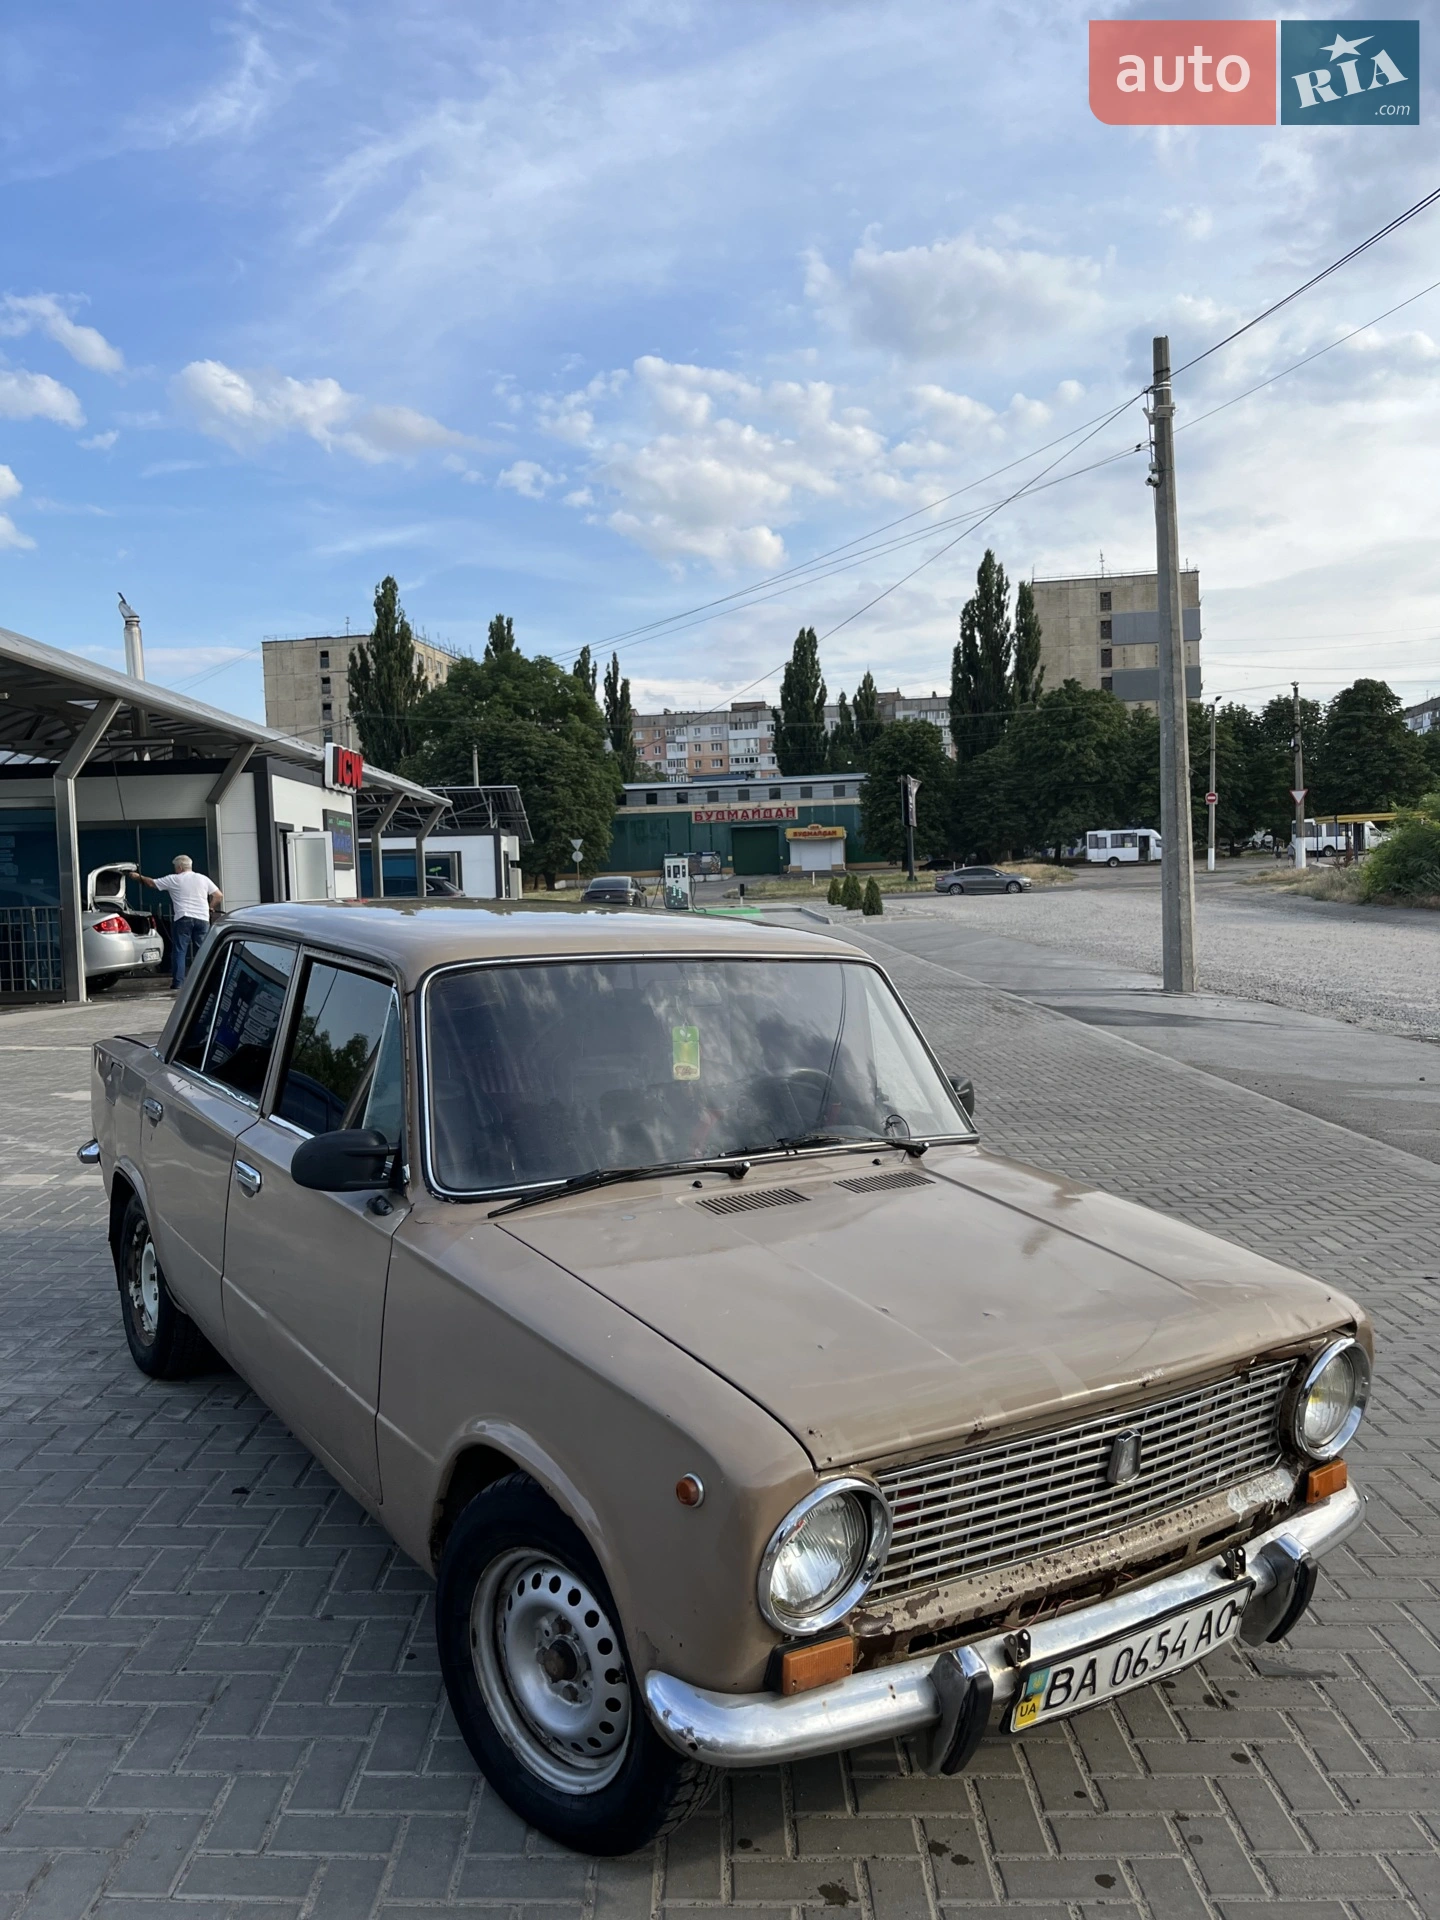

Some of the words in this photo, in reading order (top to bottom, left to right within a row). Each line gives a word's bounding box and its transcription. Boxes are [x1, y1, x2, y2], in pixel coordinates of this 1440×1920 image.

[335, 745, 364, 789] ICW
[694, 807, 796, 821] БУДМАЙДАН
[1043, 1657, 1097, 1710] BA
[1110, 1619, 1189, 1687] 0654
[1019, 1701, 1037, 1718] UA
